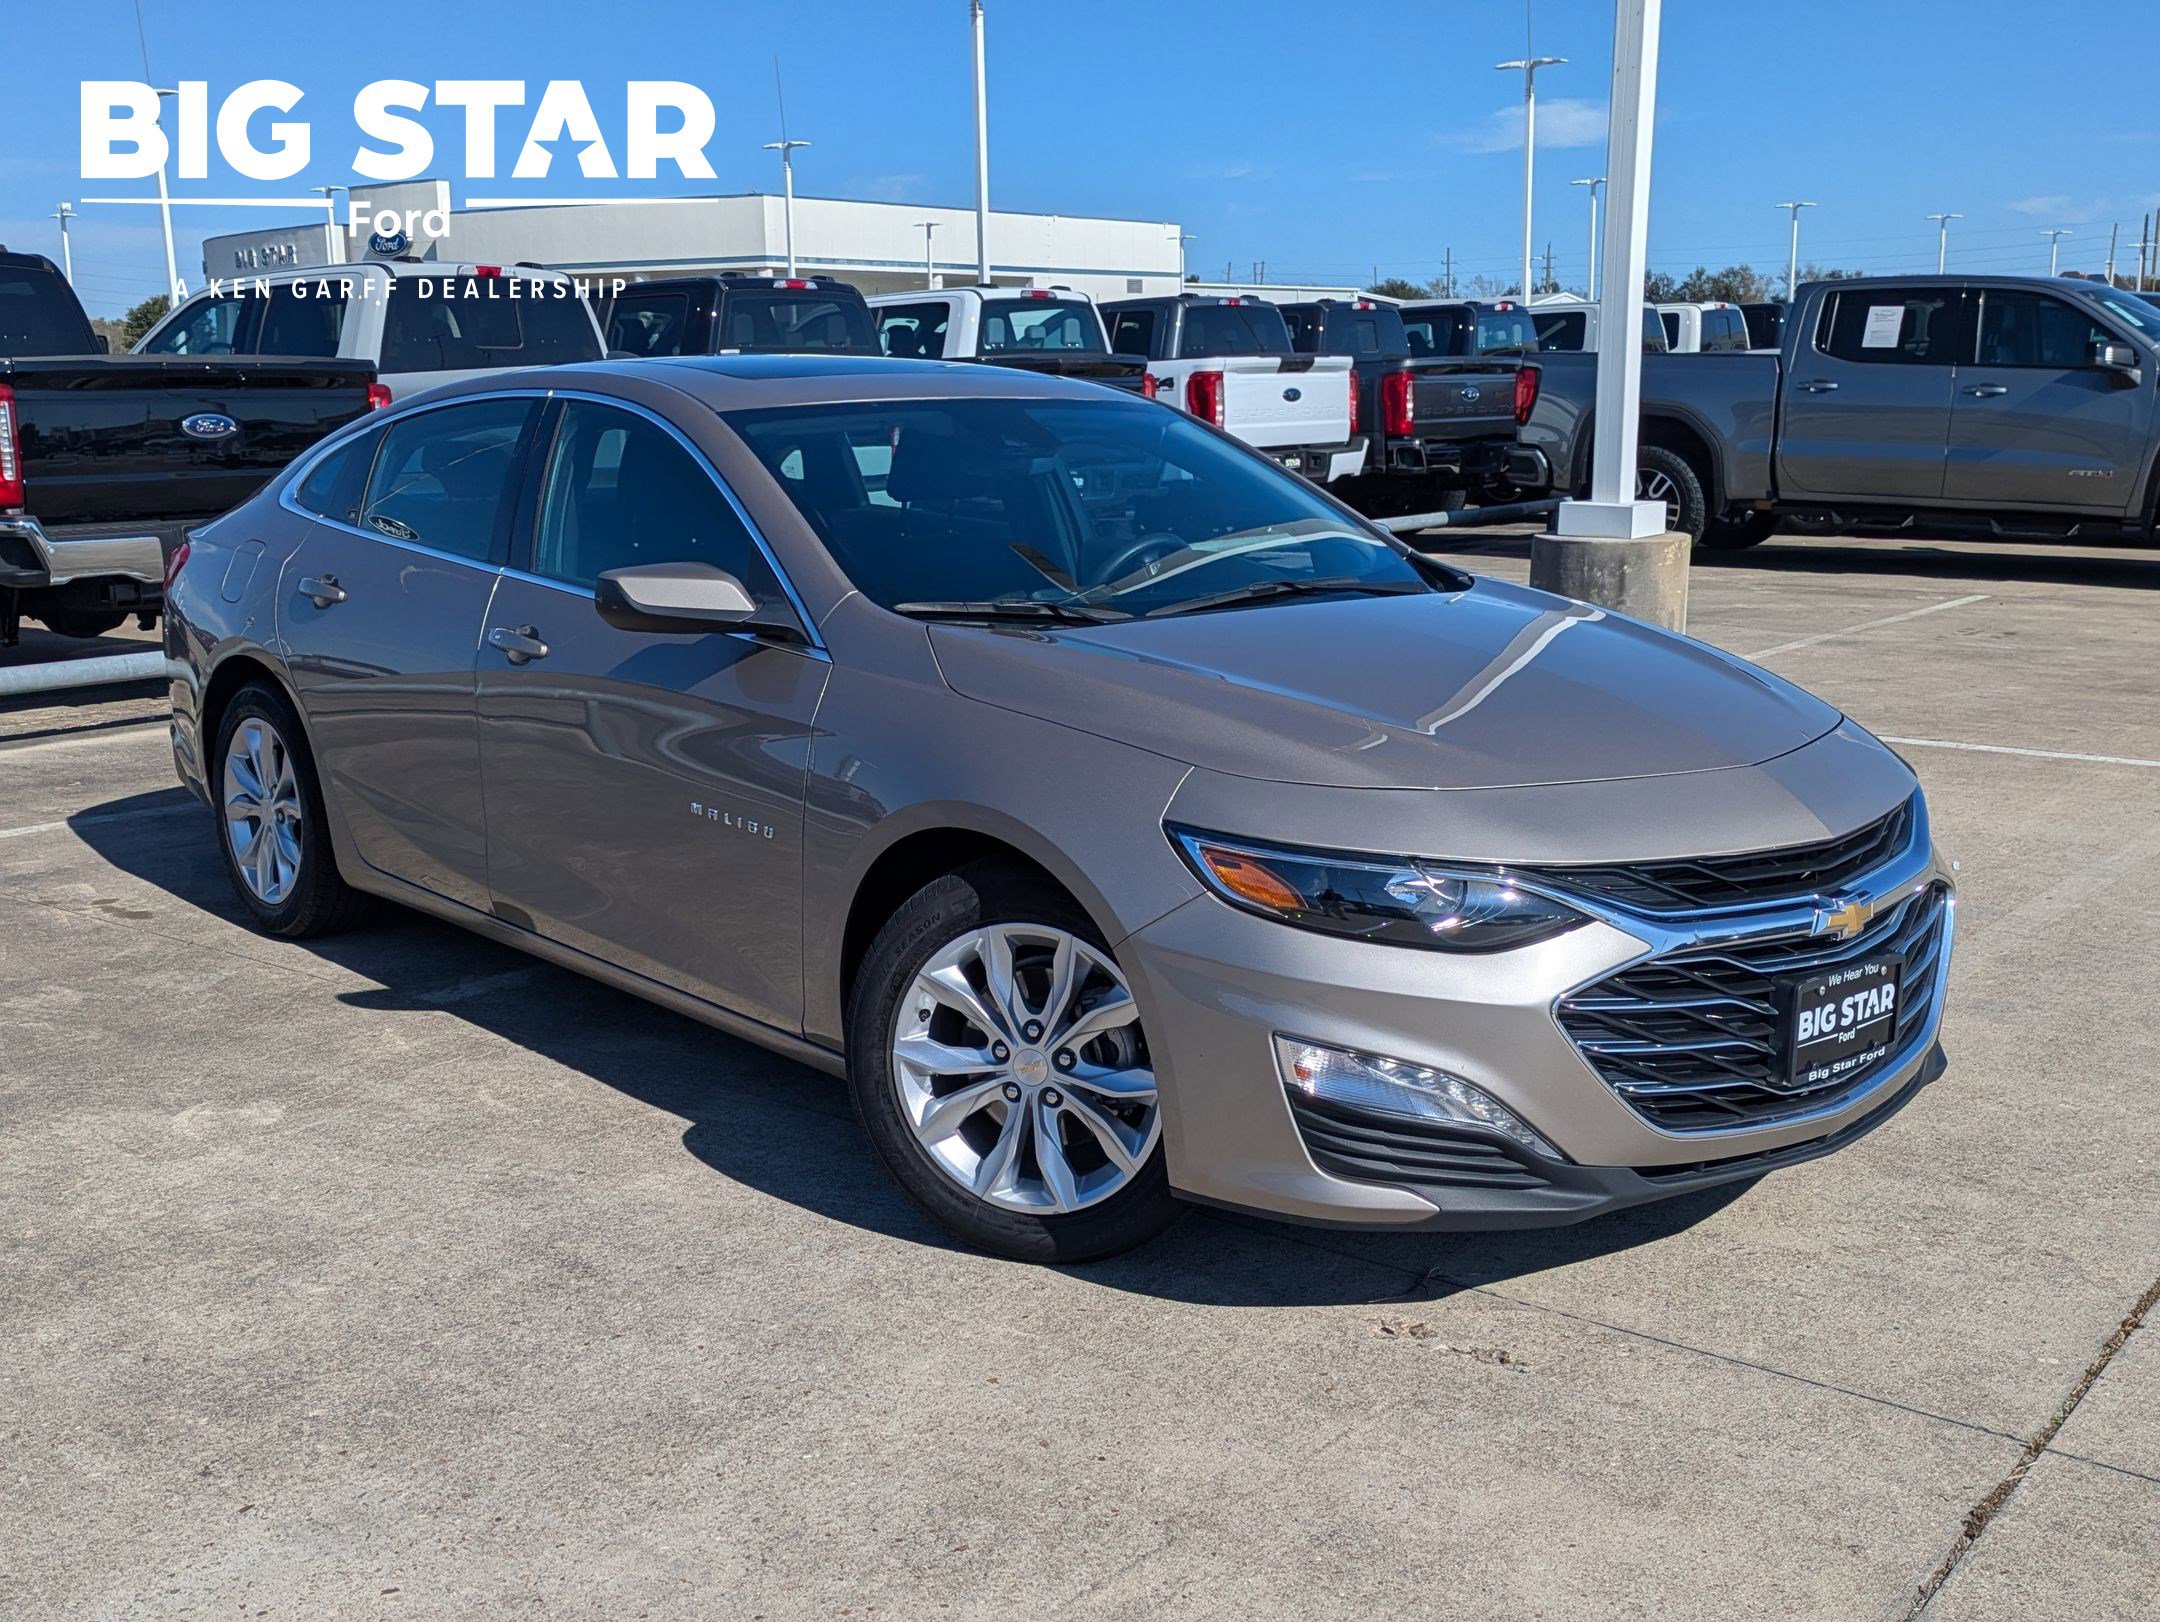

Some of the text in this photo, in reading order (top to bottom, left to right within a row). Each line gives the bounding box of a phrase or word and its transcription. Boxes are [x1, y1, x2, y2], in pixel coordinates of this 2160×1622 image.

[261, 243, 297, 267] STAR
[689, 801, 774, 839] MALIBU
[894, 912, 941, 957] SEASON
[1828, 963, 1880, 988] We Hear You
[1797, 983, 1895, 1042] BIG STAR
[1838, 1027, 1856, 1044] Ford
[1808, 1046, 1886, 1082] Big Star Ford
